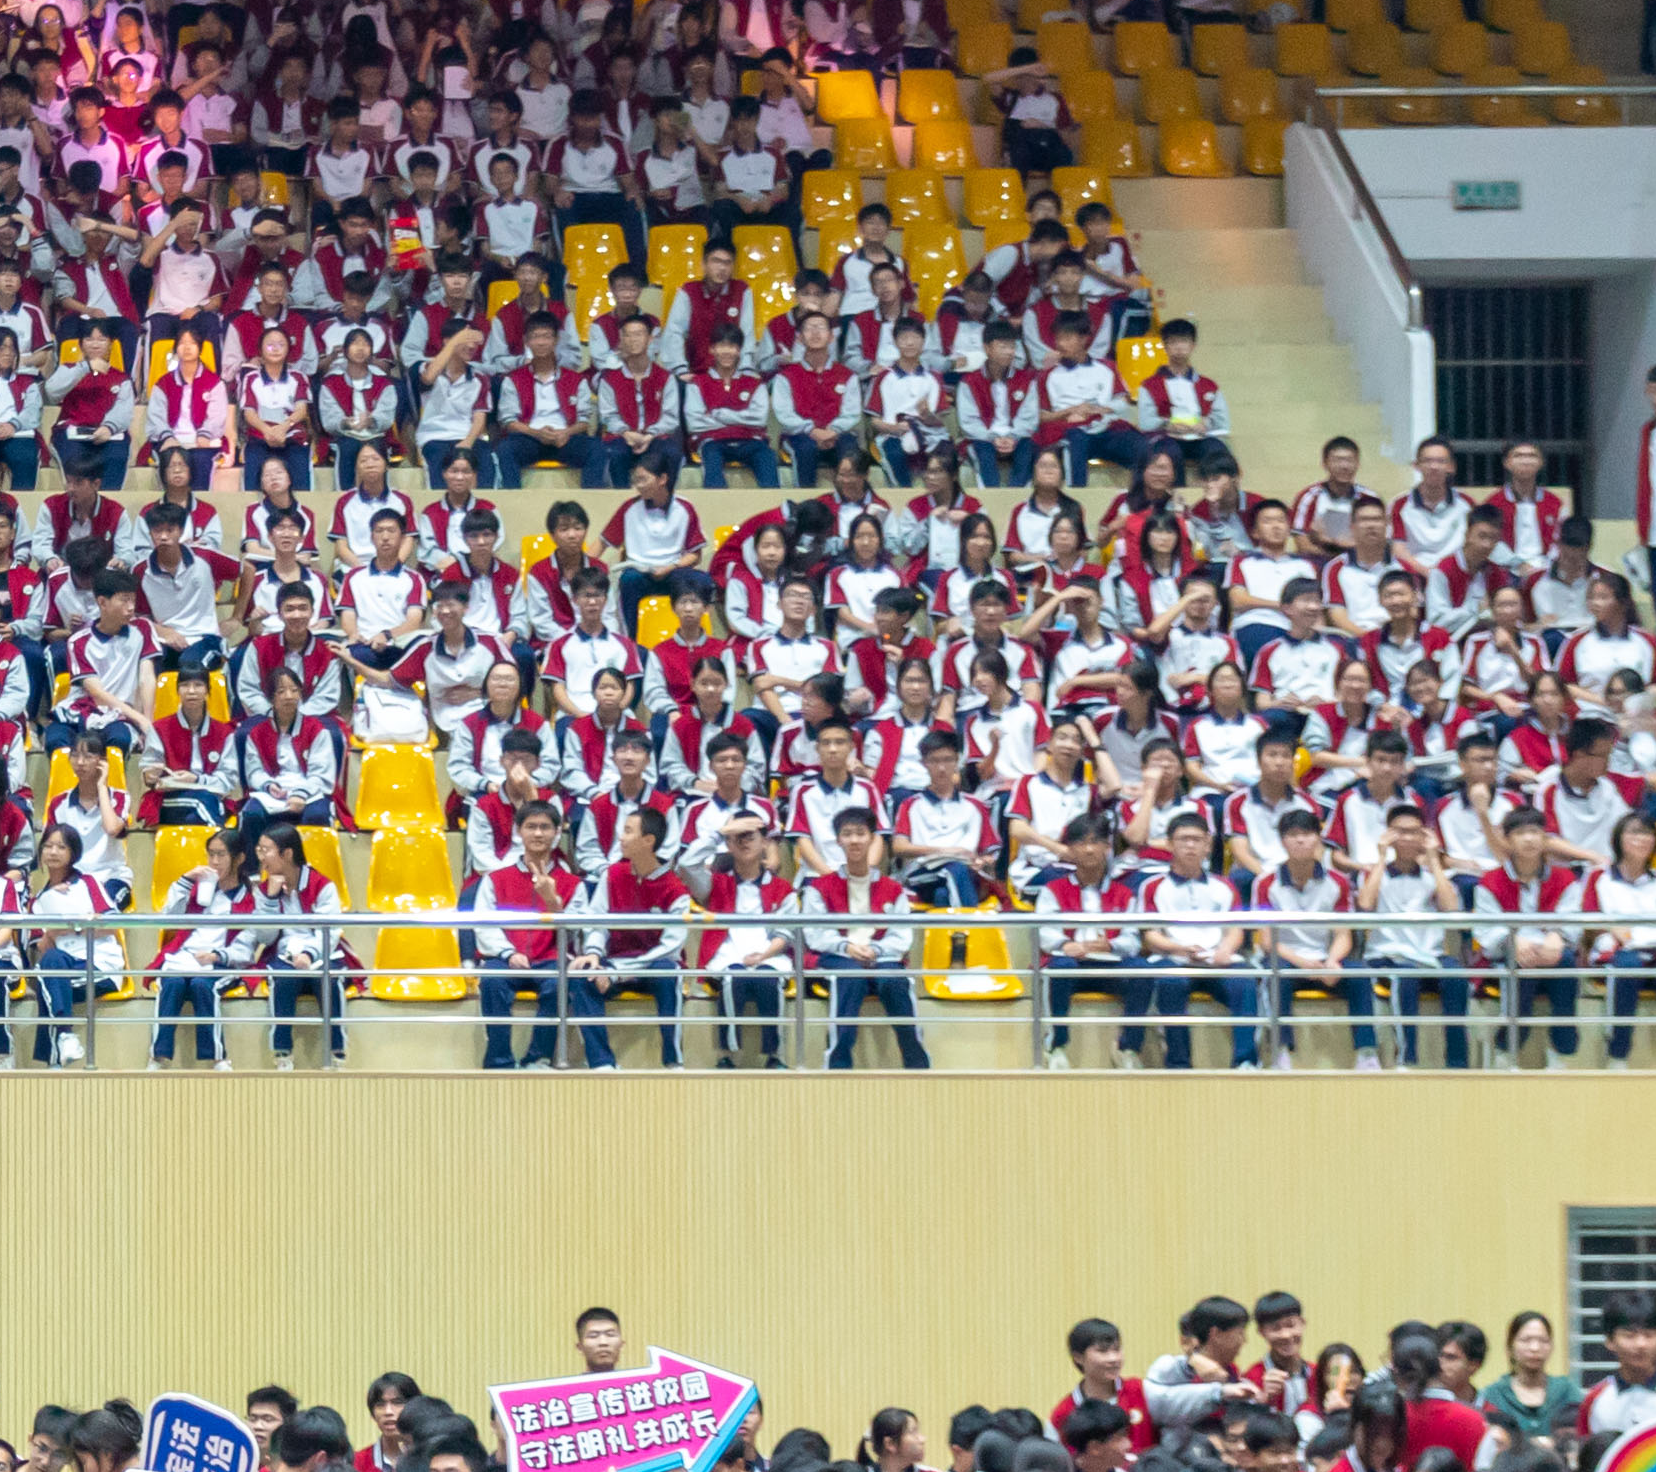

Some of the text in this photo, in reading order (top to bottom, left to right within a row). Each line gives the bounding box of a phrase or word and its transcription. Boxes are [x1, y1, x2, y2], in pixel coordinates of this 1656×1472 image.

[511, 1370, 711, 1435] 法治宣传进校园
[520, 1409, 718, 1470] 守法明礼共成长
